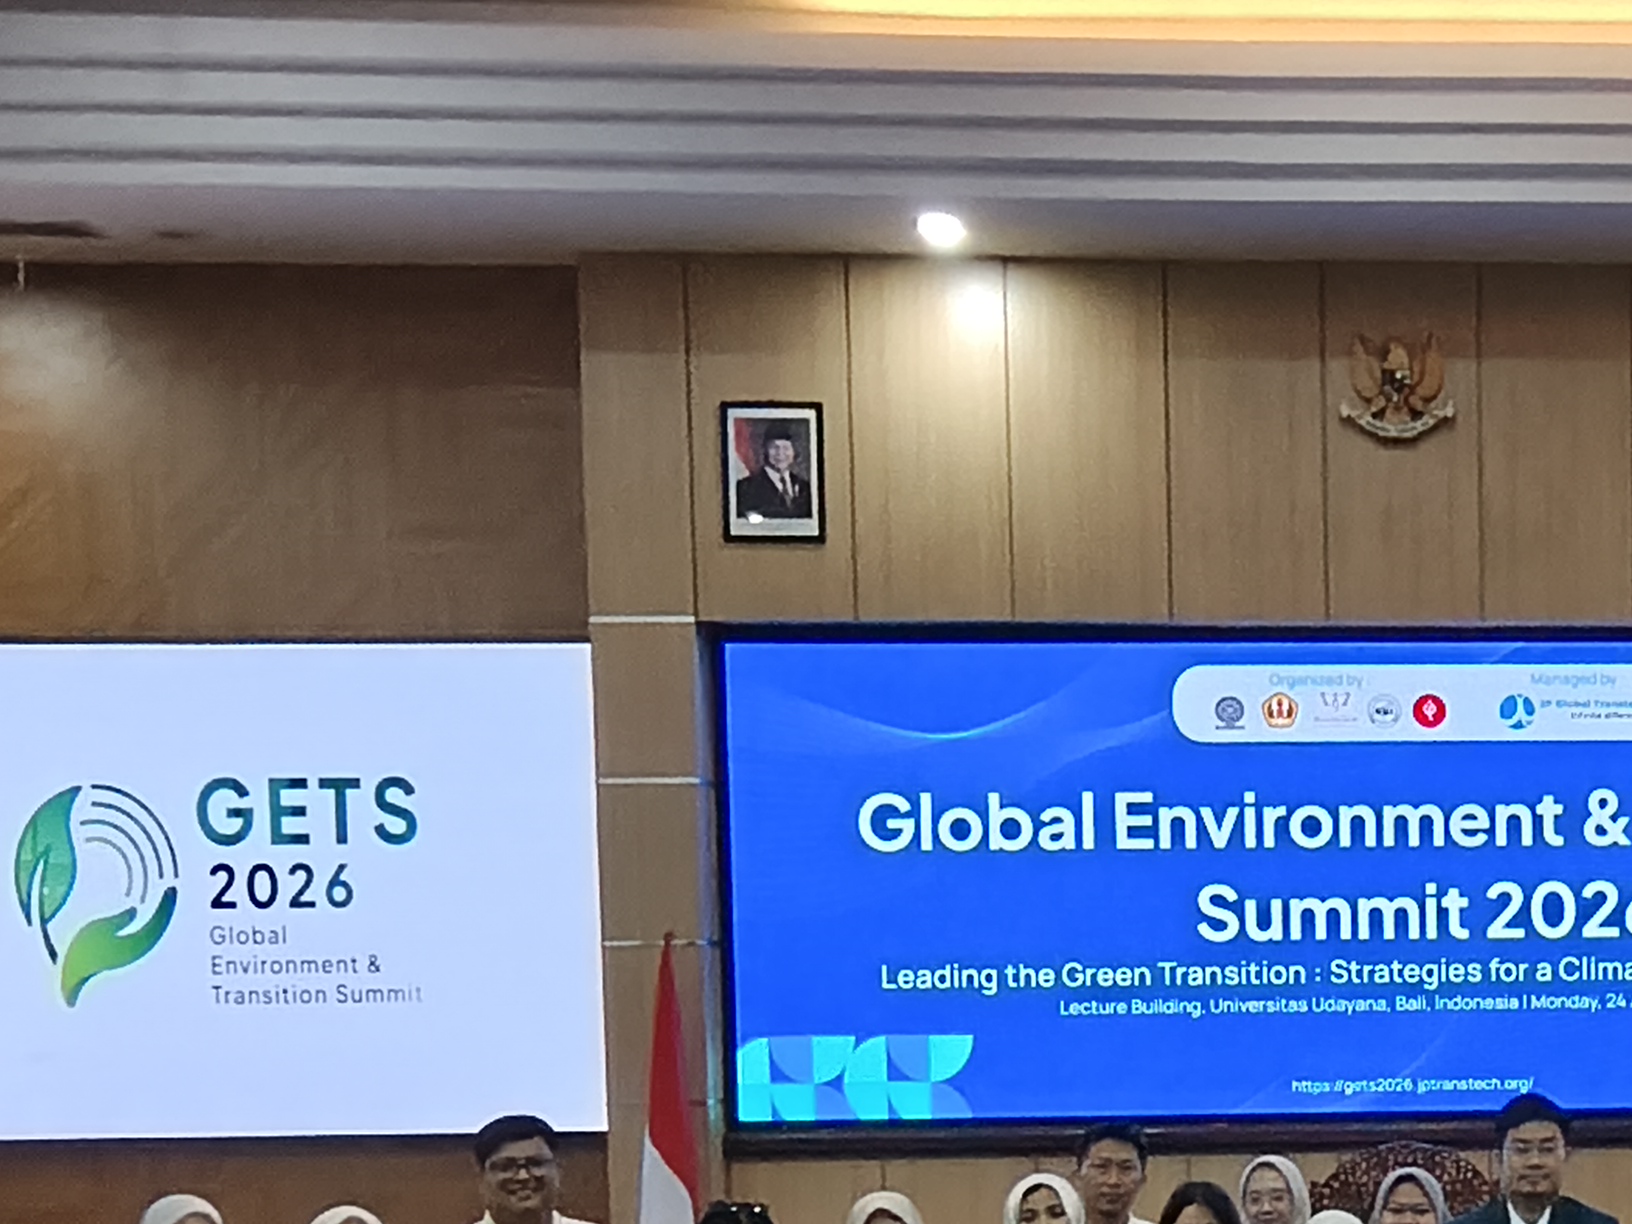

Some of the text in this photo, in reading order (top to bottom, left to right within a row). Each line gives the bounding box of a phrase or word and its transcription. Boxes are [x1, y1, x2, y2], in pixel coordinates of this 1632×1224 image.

[1345, 672, 1364, 689] by
[1600, 672, 1617, 689] by
[196, 775, 418, 847] GETS
[858, 790, 1095, 853] Global
[1114, 790, 1566, 850] Environment
[1583, 788, 1632, 848] &
[208, 862, 354, 910] 2026
[1196, 881, 1470, 943] Summit
[209, 924, 288, 946] Global
[211, 954, 382, 976] Environment &
[881, 962, 998, 995] Leading
[1004, 962, 1056, 989] the
[1061, 961, 1152, 988] Green
[1157, 959, 1306, 987] Transition
[1330, 957, 1482, 990] Strategies
[1488, 957, 1528, 983] for
[1535, 963, 1552, 982] a
[211, 984, 423, 1006] Transition Summit
[1059, 999, 1129, 1016] Lecture
[1210, 996, 1309, 1015] Universitas
[1312, 995, 1391, 1017] Udayana,
[1396, 994, 1431, 1013] Bali,
[1435, 993, 1519, 1011] Indonesia
[1531, 993, 1602, 1014] Monday,
[1606, 992, 1627, 1010] 24
